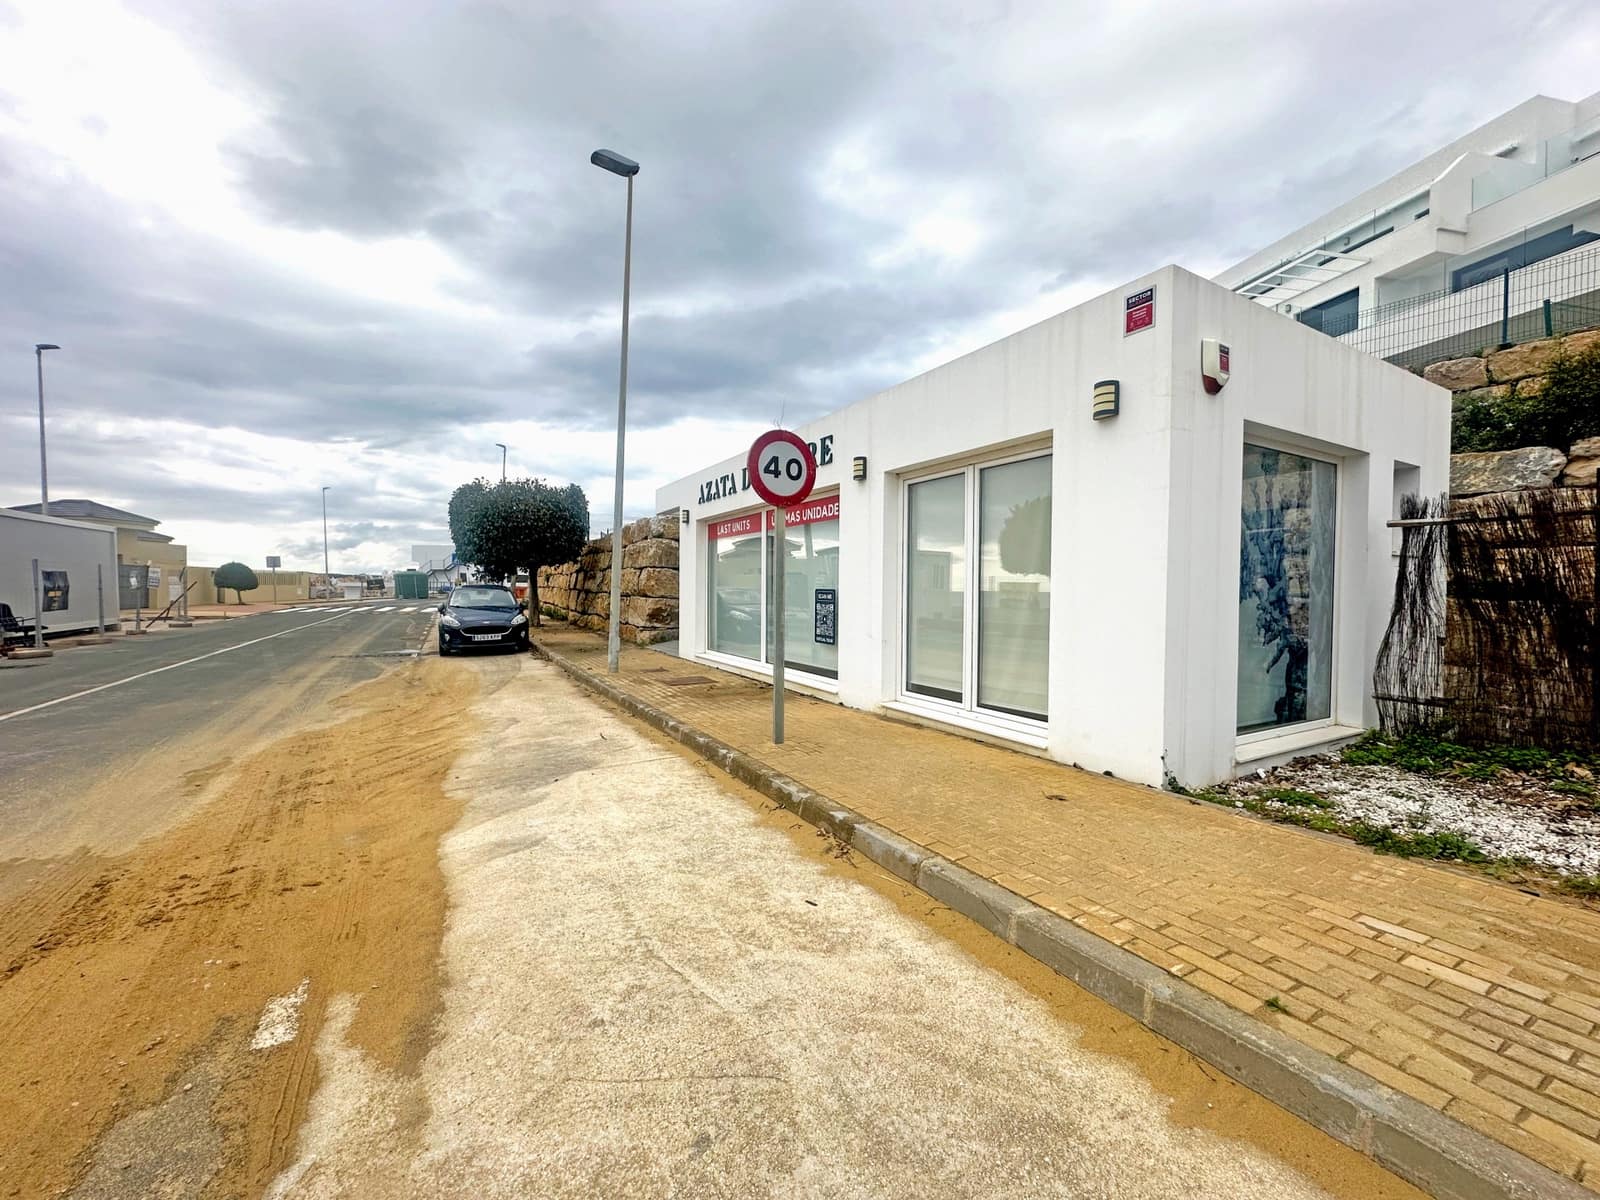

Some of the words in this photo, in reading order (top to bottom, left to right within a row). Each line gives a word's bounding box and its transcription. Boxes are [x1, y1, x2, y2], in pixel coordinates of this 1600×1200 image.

[763, 455, 803, 481] 40
[698, 473, 738, 504] AZATA
[802, 502, 839, 521] UNIDADE
[717, 523, 731, 536] LAST
[732, 519, 751, 533] UNITS
